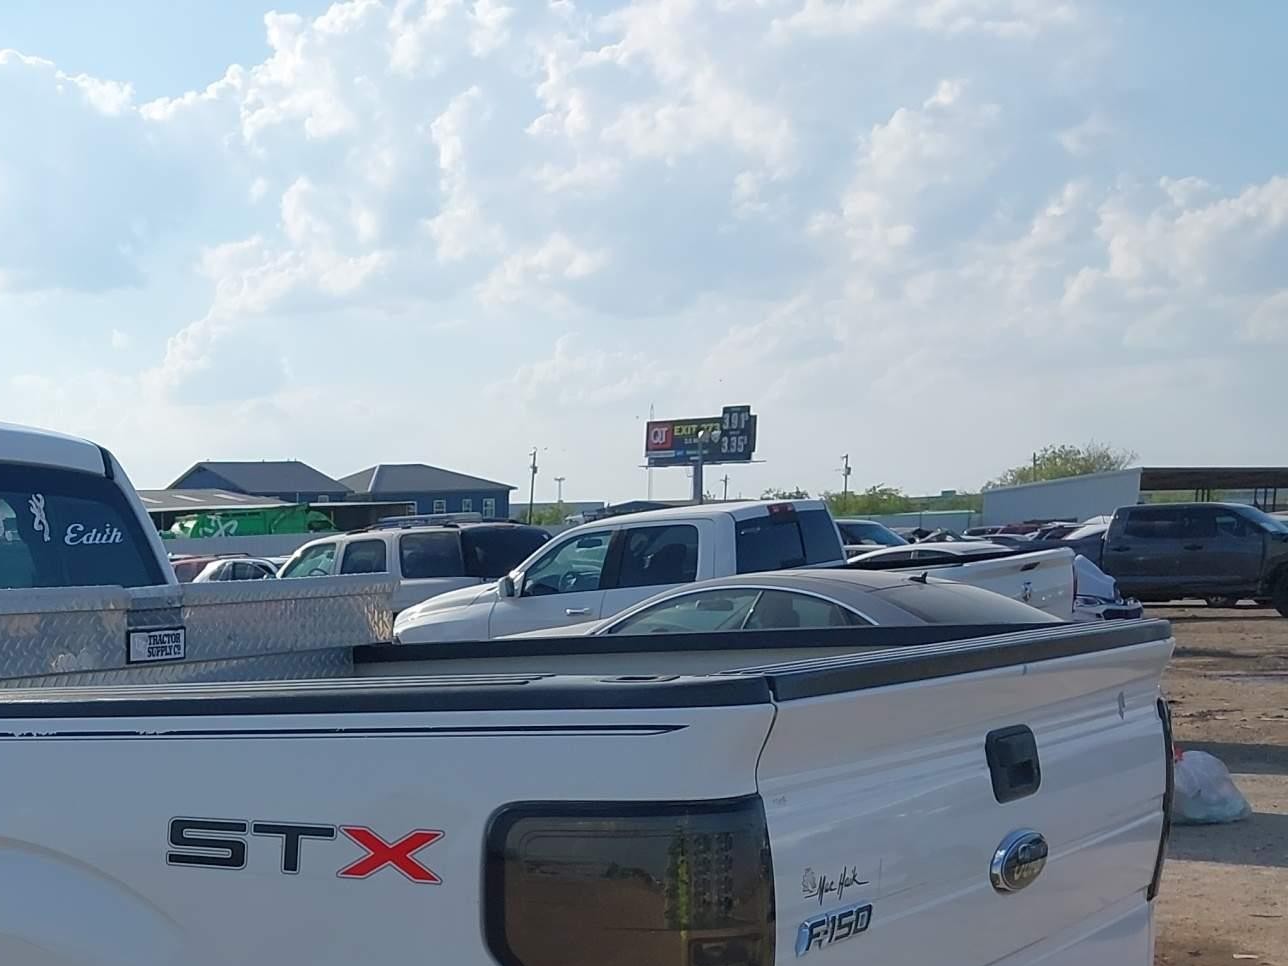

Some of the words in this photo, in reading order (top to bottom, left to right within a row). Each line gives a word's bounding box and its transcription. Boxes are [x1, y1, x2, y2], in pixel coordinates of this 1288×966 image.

[652, 428, 668, 444] QT
[674, 425, 698, 436] EXIT
[147, 633, 181, 646] TRACTOR
[147, 645, 173, 658] SUPPLY
[165, 815, 446, 885] STX
